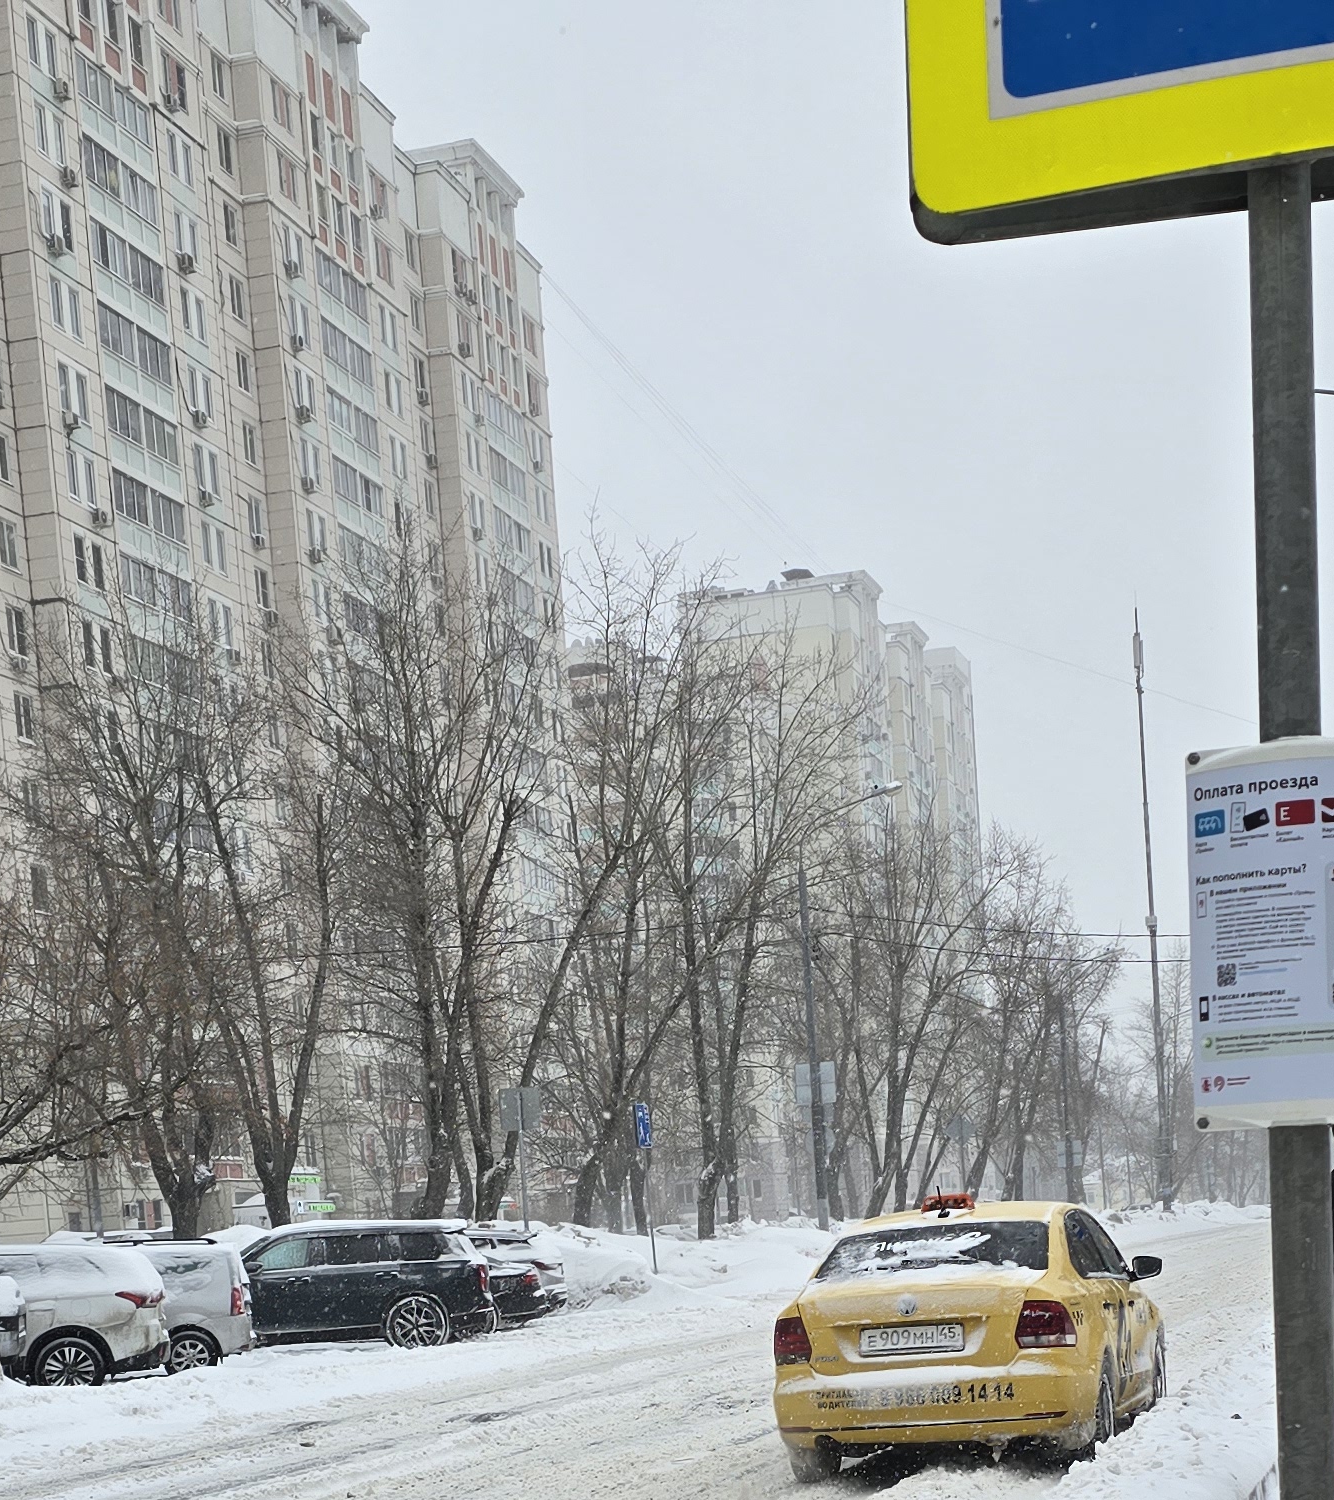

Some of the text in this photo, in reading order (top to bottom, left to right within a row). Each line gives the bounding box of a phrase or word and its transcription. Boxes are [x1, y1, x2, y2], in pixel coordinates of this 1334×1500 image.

[1193, 775, 1319, 802] Оплата проезда
[1195, 863, 1307, 887] Как пополнить карты?
[968, 1383, 988, 1402] 14
[994, 1381, 1015, 1401] 14
